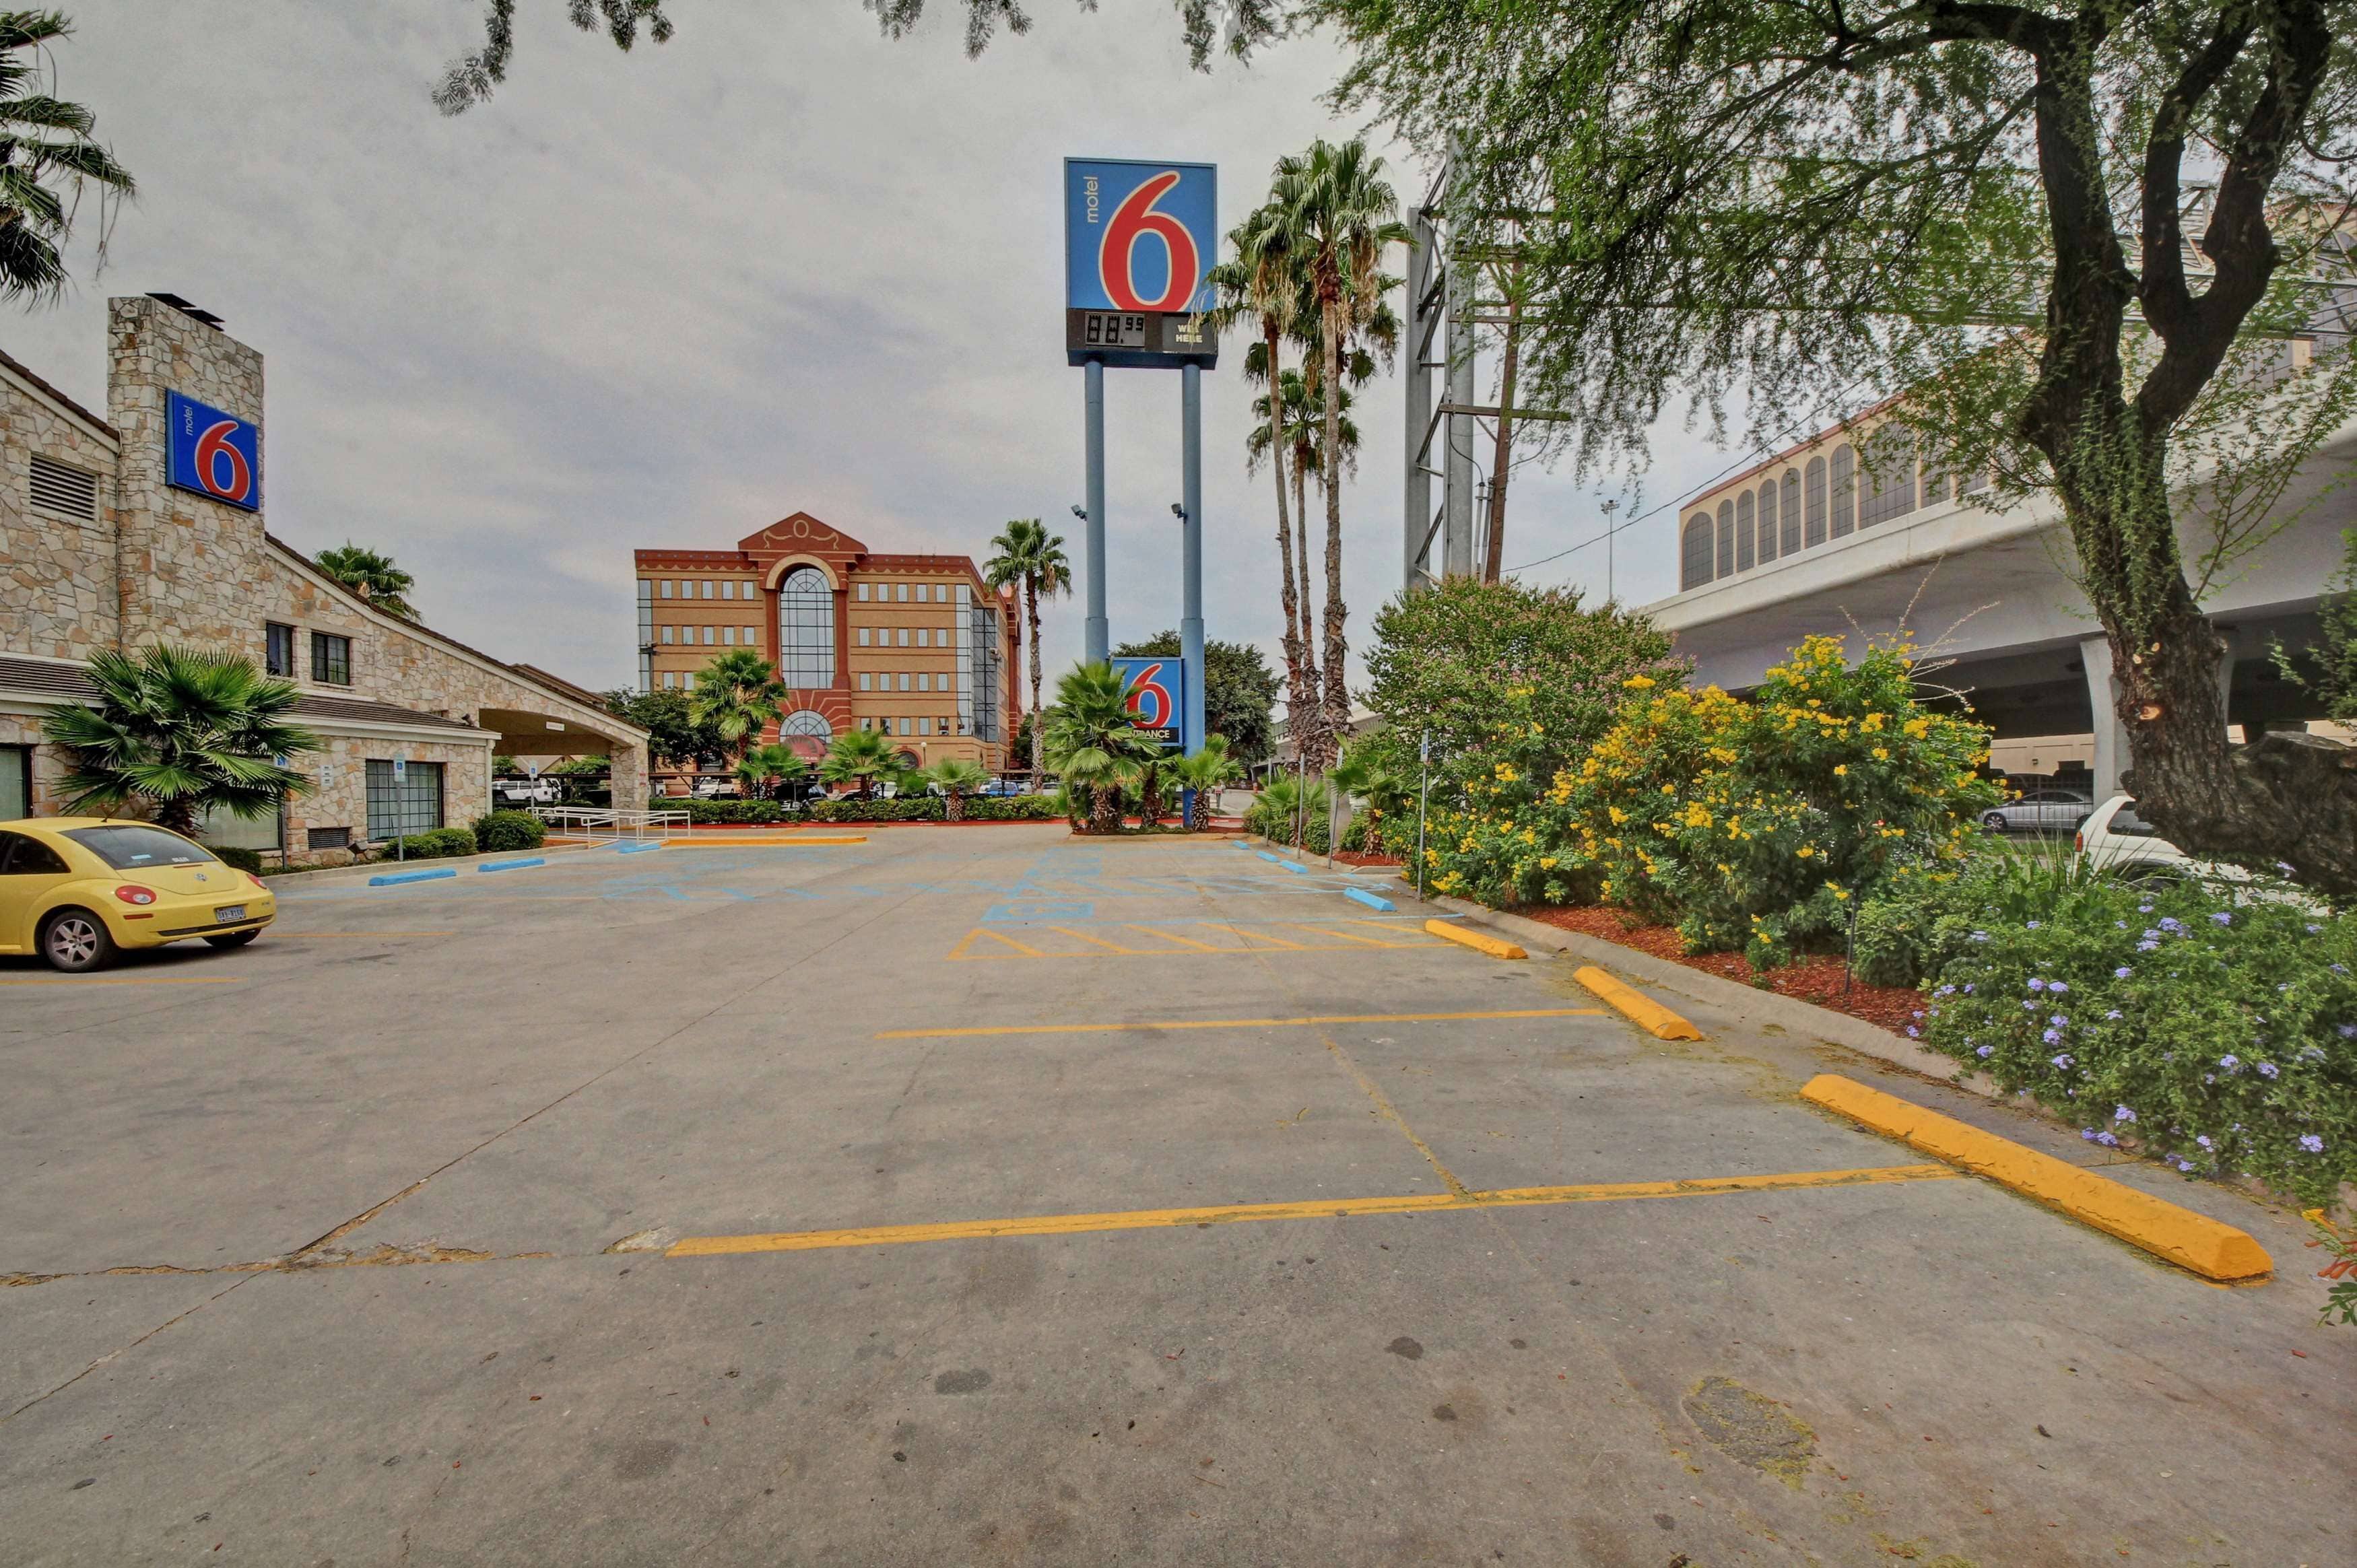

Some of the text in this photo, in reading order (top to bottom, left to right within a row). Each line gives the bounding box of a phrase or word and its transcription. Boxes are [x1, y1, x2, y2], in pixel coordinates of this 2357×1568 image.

[1084, 176, 1098, 223] motel
[1098, 170, 1199, 312] 6
[183, 405, 193, 436] motel
[195, 420, 251, 502] 6
[1125, 663, 1172, 728] 6
[1131, 729, 1170, 739] NTANCE
